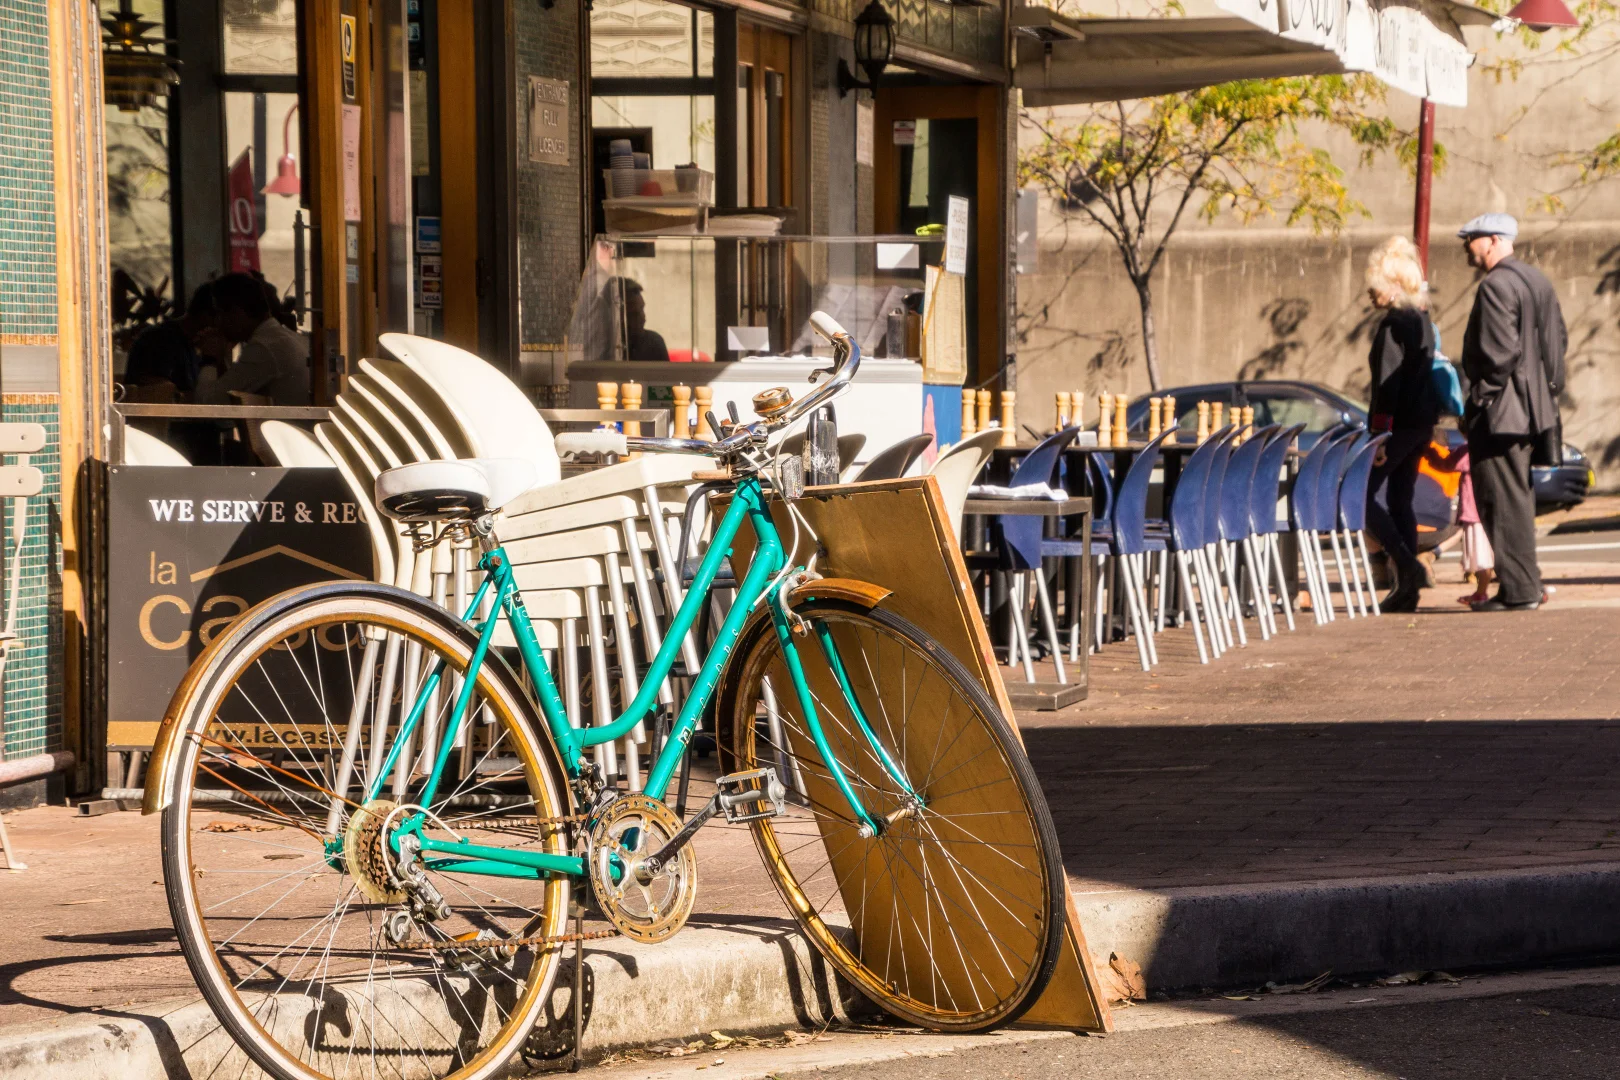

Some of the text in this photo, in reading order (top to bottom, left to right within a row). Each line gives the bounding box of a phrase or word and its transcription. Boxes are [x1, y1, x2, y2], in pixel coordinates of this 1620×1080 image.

[537, 83, 566, 102] ENTRANCE
[149, 500, 194, 522] WE
[202, 500, 285, 523] SERVE
[294, 501, 314, 523] &
[150, 551, 177, 585] la
